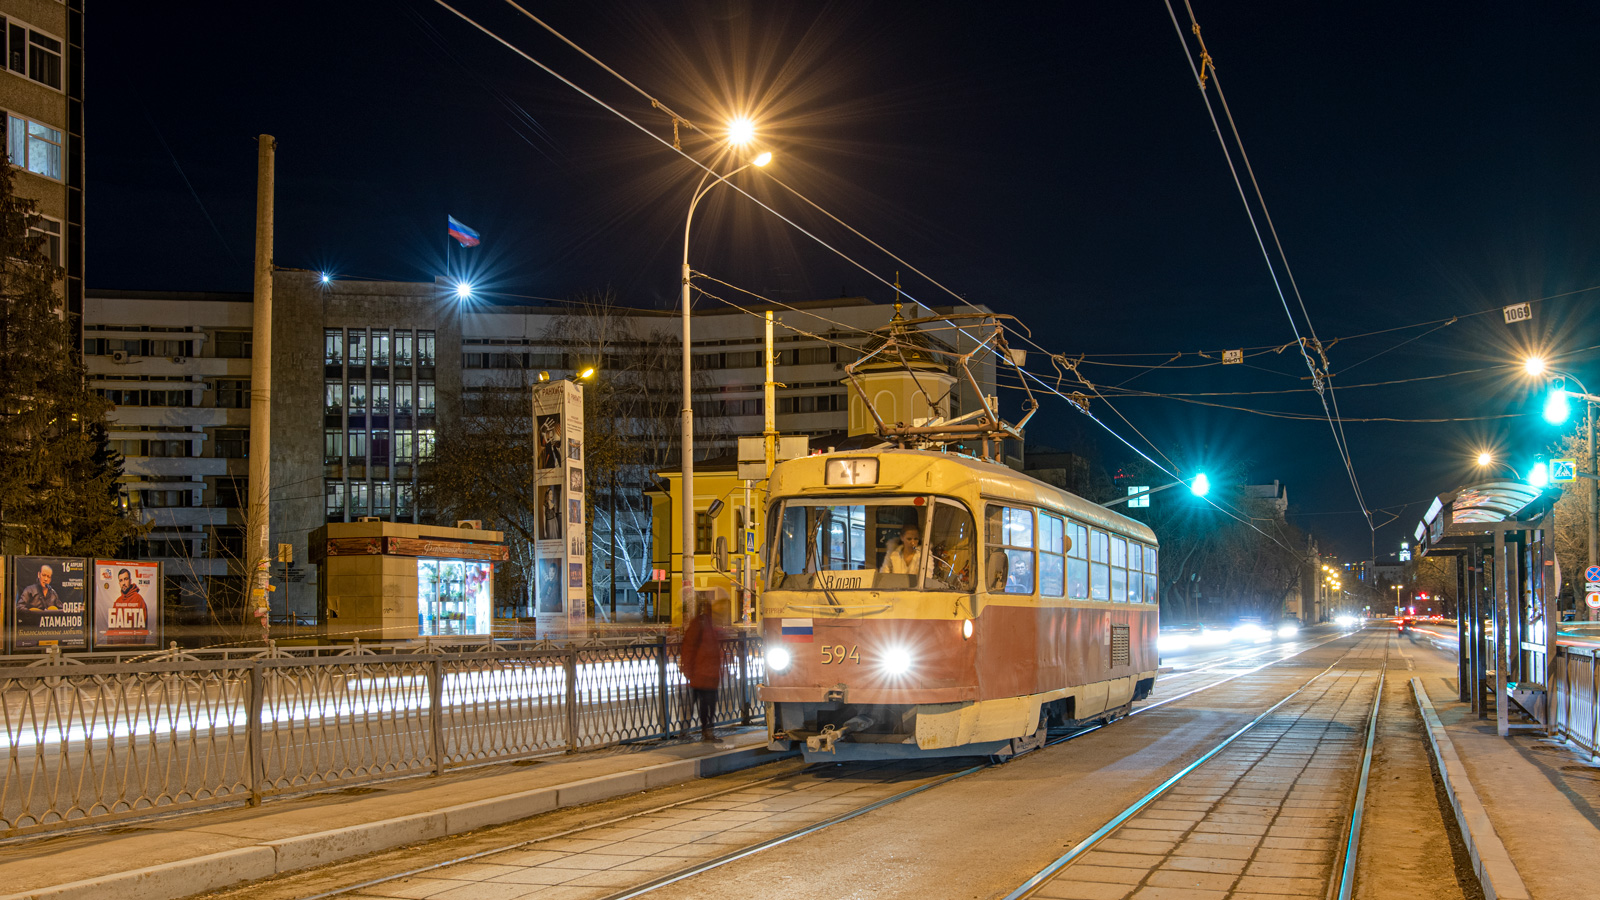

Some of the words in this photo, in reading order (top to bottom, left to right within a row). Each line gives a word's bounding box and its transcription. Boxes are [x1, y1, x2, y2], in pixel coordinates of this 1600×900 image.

[1505, 306, 1530, 321] 1069
[840, 460, 860, 485] 4
[62, 562, 70, 573] 16
[62, 602, 81, 613] ОЛЕГ
[39, 616, 82, 628] АТАМАНОВ
[108, 608, 145, 628] БАСТА
[821, 645, 860, 665] 594
